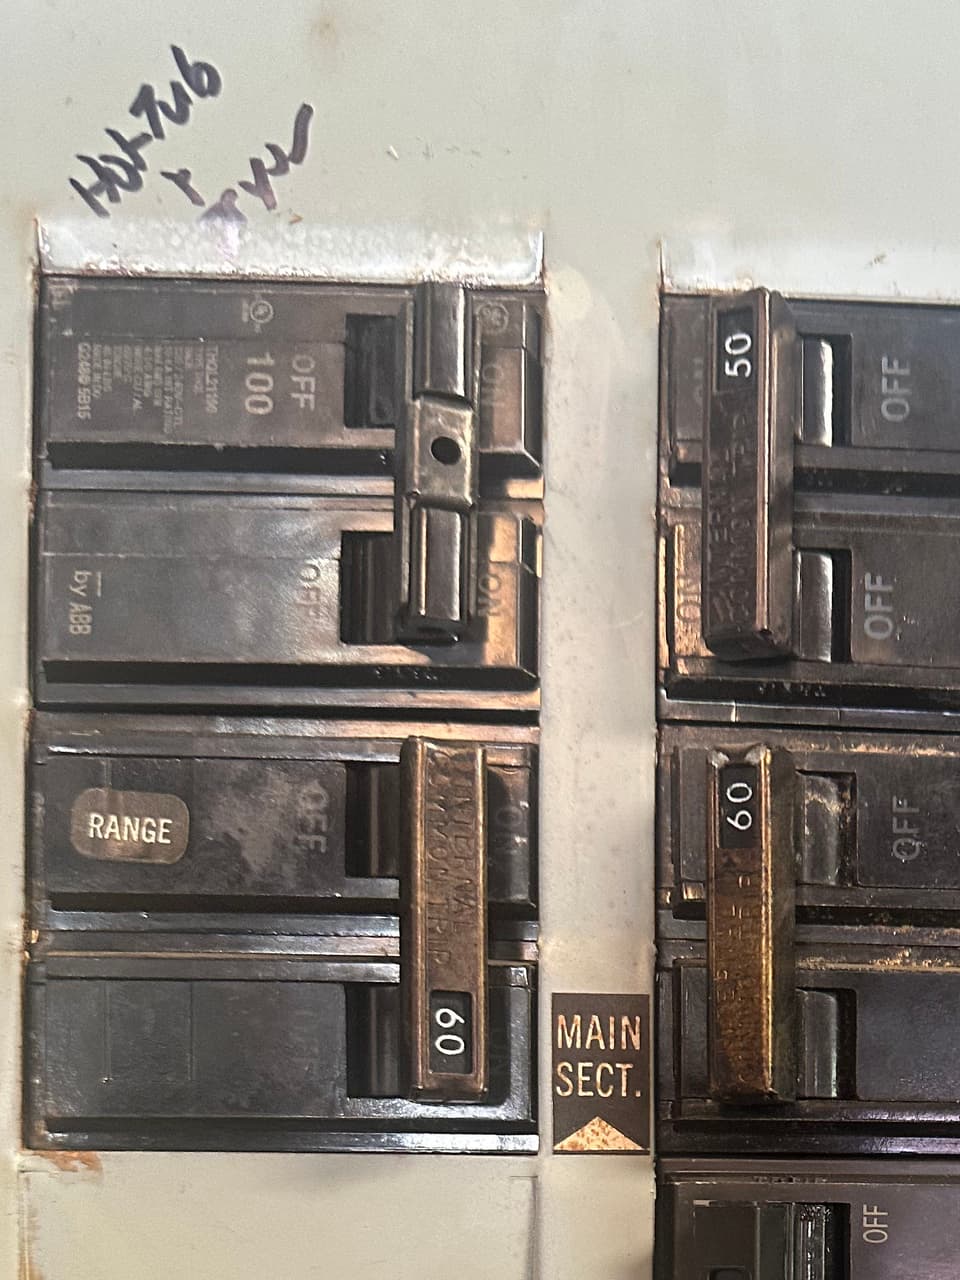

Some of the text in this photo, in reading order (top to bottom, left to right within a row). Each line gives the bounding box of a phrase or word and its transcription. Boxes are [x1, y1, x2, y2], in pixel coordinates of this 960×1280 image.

[724, 332, 753, 378] 50
[245, 352, 275, 415] 100
[290, 353, 316, 411] OFF
[881, 355, 911, 422] OFF
[68, 570, 93, 635] by ABB
[864, 572, 895, 640] OFF
[88, 815, 173, 845] RANGE
[726, 781, 753, 831] 60
[893, 795, 920, 862] OFF
[434, 1007, 465, 1056] 60
[555, 1014, 642, 1052] MAIN
[554, 1061, 642, 1099] SECT.
[862, 1204, 889, 1245] OFF
